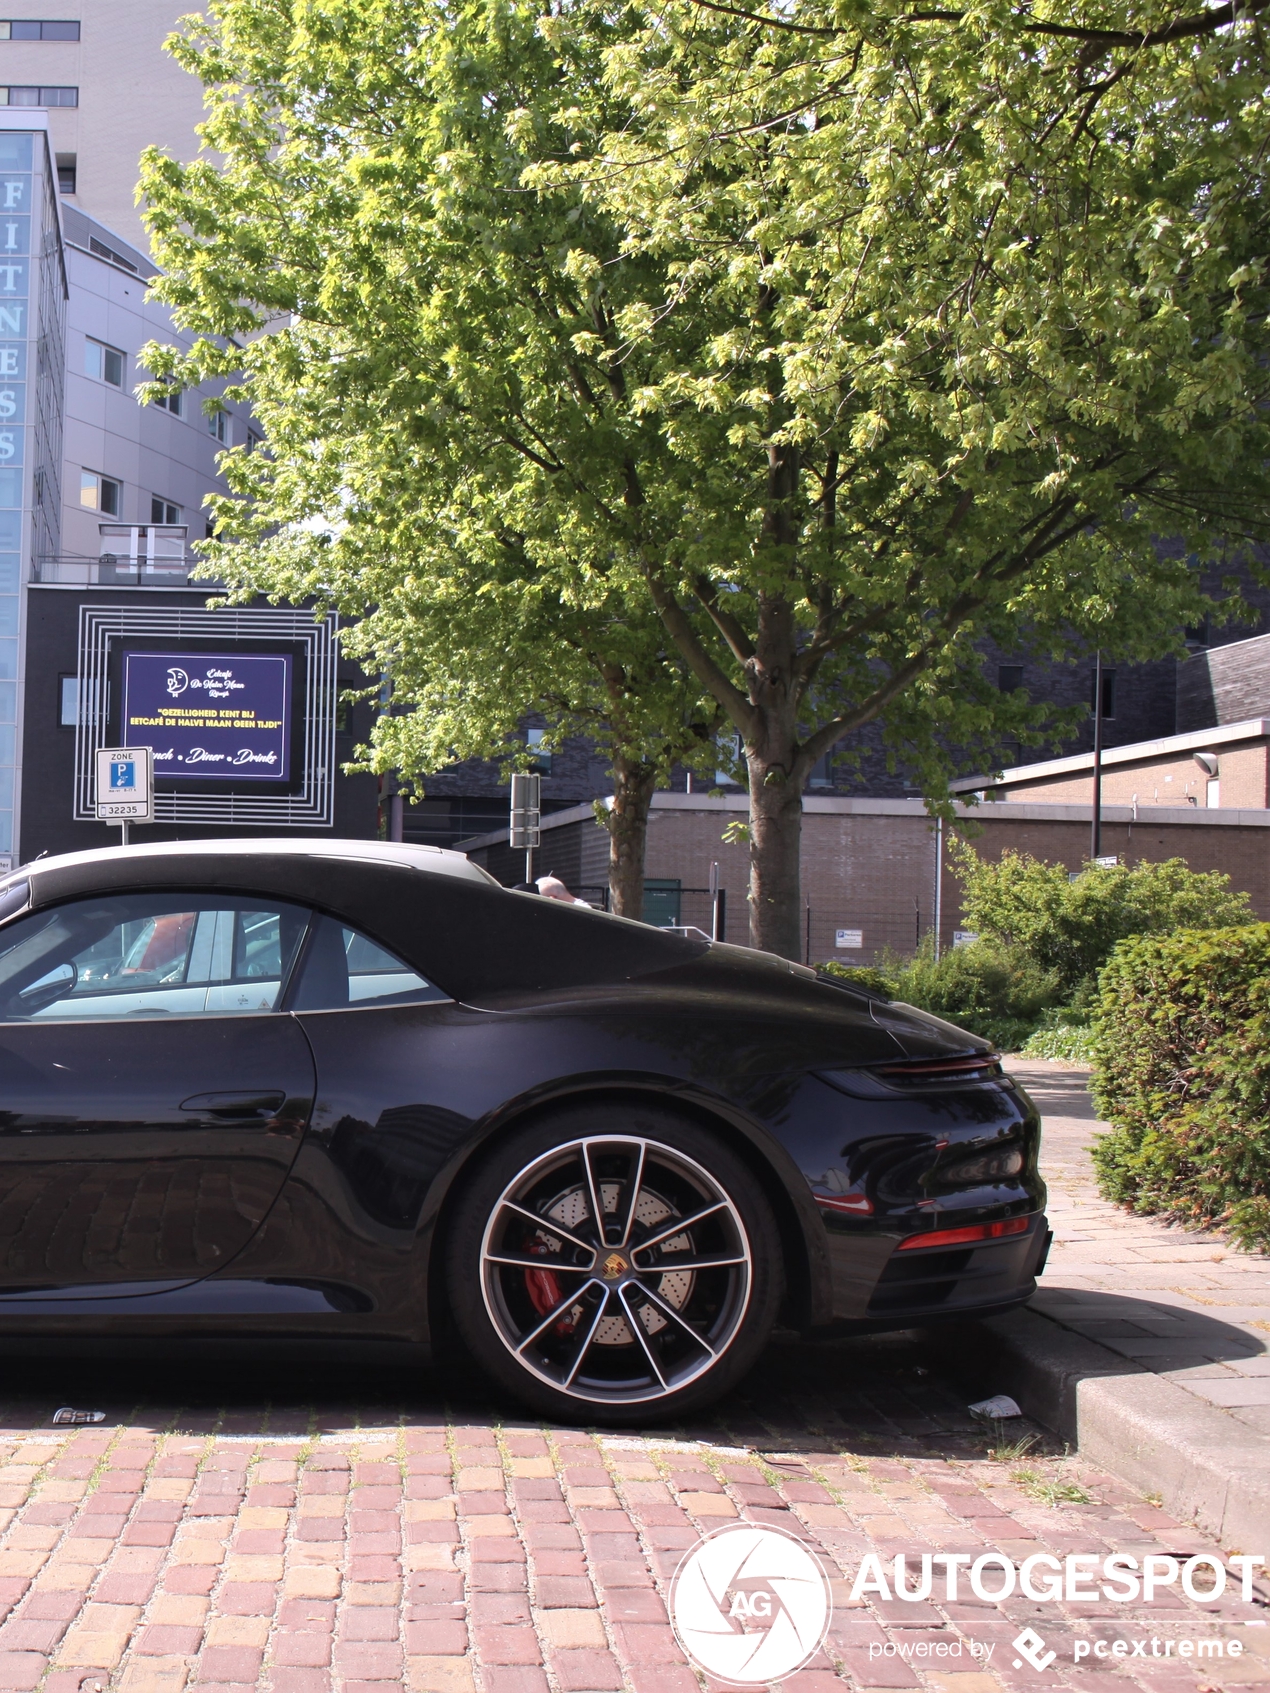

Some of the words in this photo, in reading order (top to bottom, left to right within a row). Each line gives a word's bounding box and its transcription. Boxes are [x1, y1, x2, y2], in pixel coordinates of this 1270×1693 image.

[190, 678, 203, 689] De
[158, 709, 218, 718] "GEZELLIGHEID
[219, 710, 240, 718] KENT
[130, 716, 164, 726] EETCAFÉ
[165, 718, 176, 726] DE
[178, 718, 204, 727] HALVE
[206, 719, 232, 728] MAAN
[234, 720, 256, 728] GEEN
[111, 753, 134, 761] ZONE
[185, 748, 225, 764] Diner
[232, 749, 278, 765] Drinks
[118, 764, 127, 776] P
[108, 806, 138, 814] 32235
